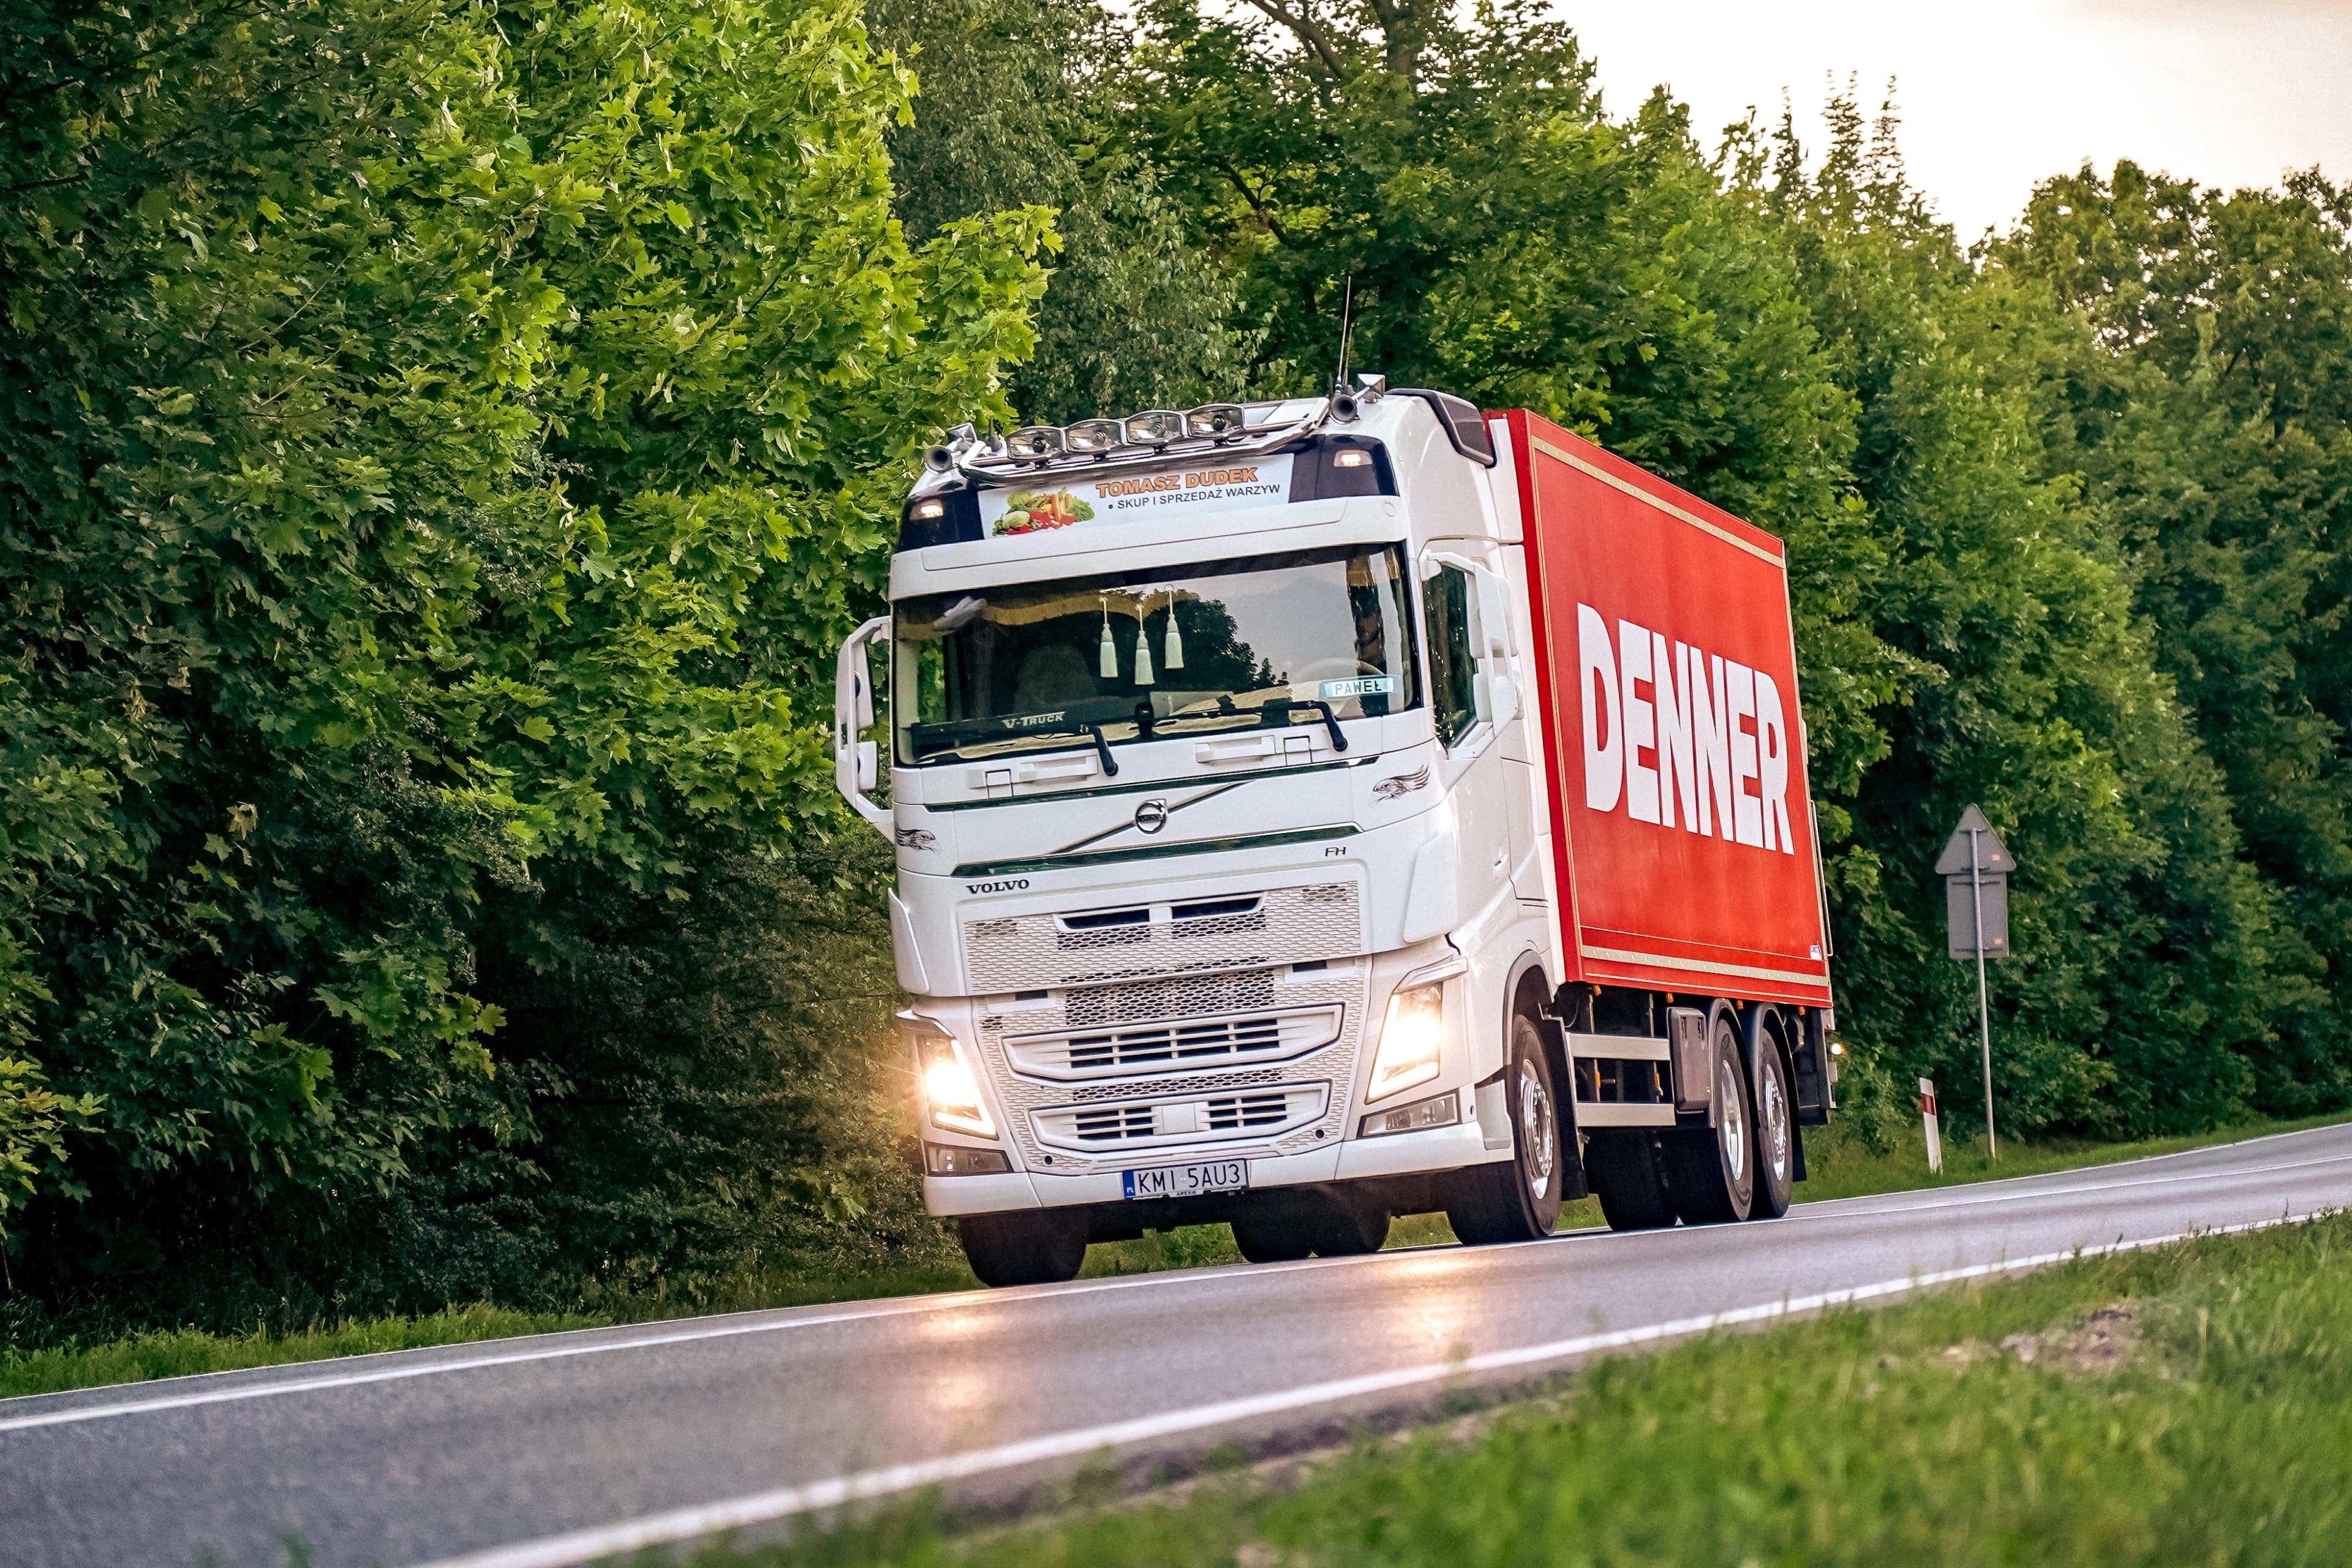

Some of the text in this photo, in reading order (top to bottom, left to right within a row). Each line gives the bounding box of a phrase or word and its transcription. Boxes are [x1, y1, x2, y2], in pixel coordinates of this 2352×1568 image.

[1096, 467, 1258, 498] TOMASZ DUDEK
[1117, 484, 1280, 509] SKUP I SPRZEDAŻ WARZYW
[1335, 680, 1382, 695] PAWEŁ
[1577, 601, 1795, 856] DENNER
[1325, 846, 1346, 856] FH
[966, 879, 1029, 894] VOLVO
[1138, 1164, 1240, 1193] KMI 5AU3
